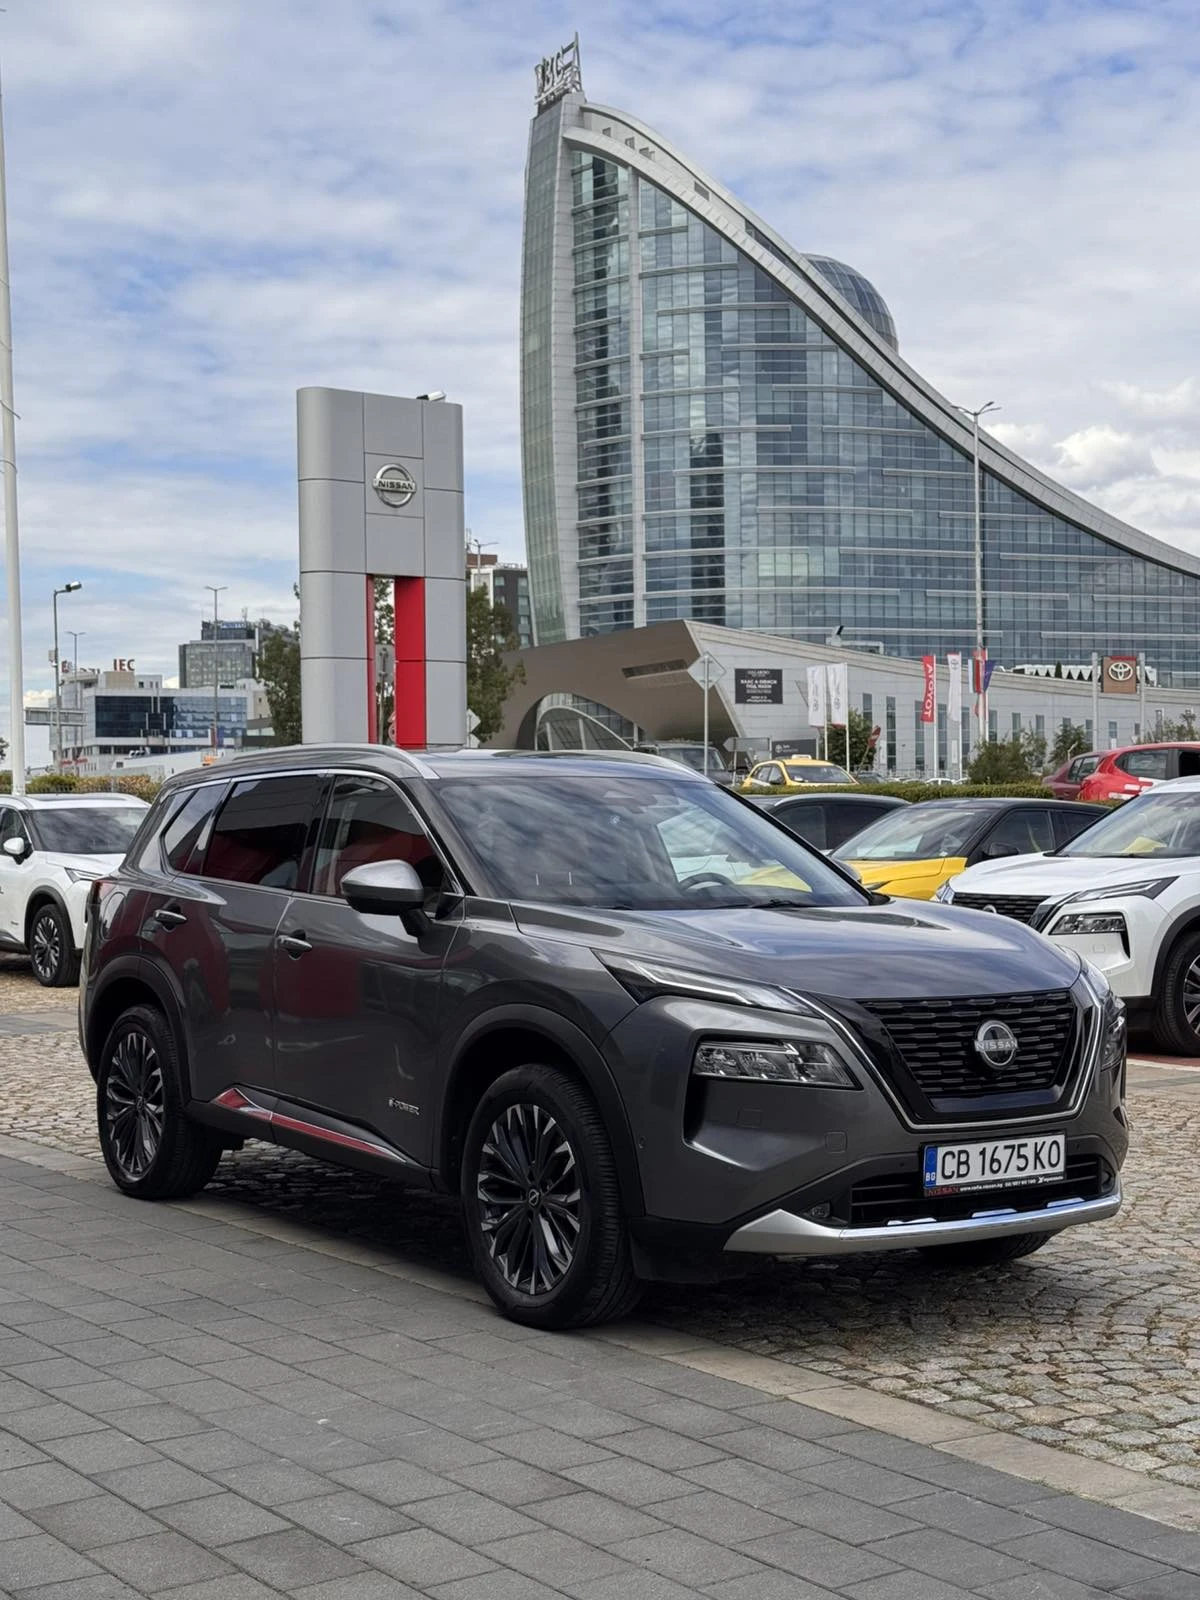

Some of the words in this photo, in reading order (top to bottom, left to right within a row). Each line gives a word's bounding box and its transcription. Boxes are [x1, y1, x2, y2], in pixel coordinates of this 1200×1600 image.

[378, 480, 413, 490] NISSAN
[113, 658, 135, 671] IEC
[975, 1040, 1018, 1050] NISSAN
[941, 1149, 970, 1180] CB
[979, 1142, 1029, 1176] 1675
[1034, 1140, 1061, 1170] KO
[925, 1171, 936, 1182] BG
[927, 1186, 960, 1197] NISSAN
